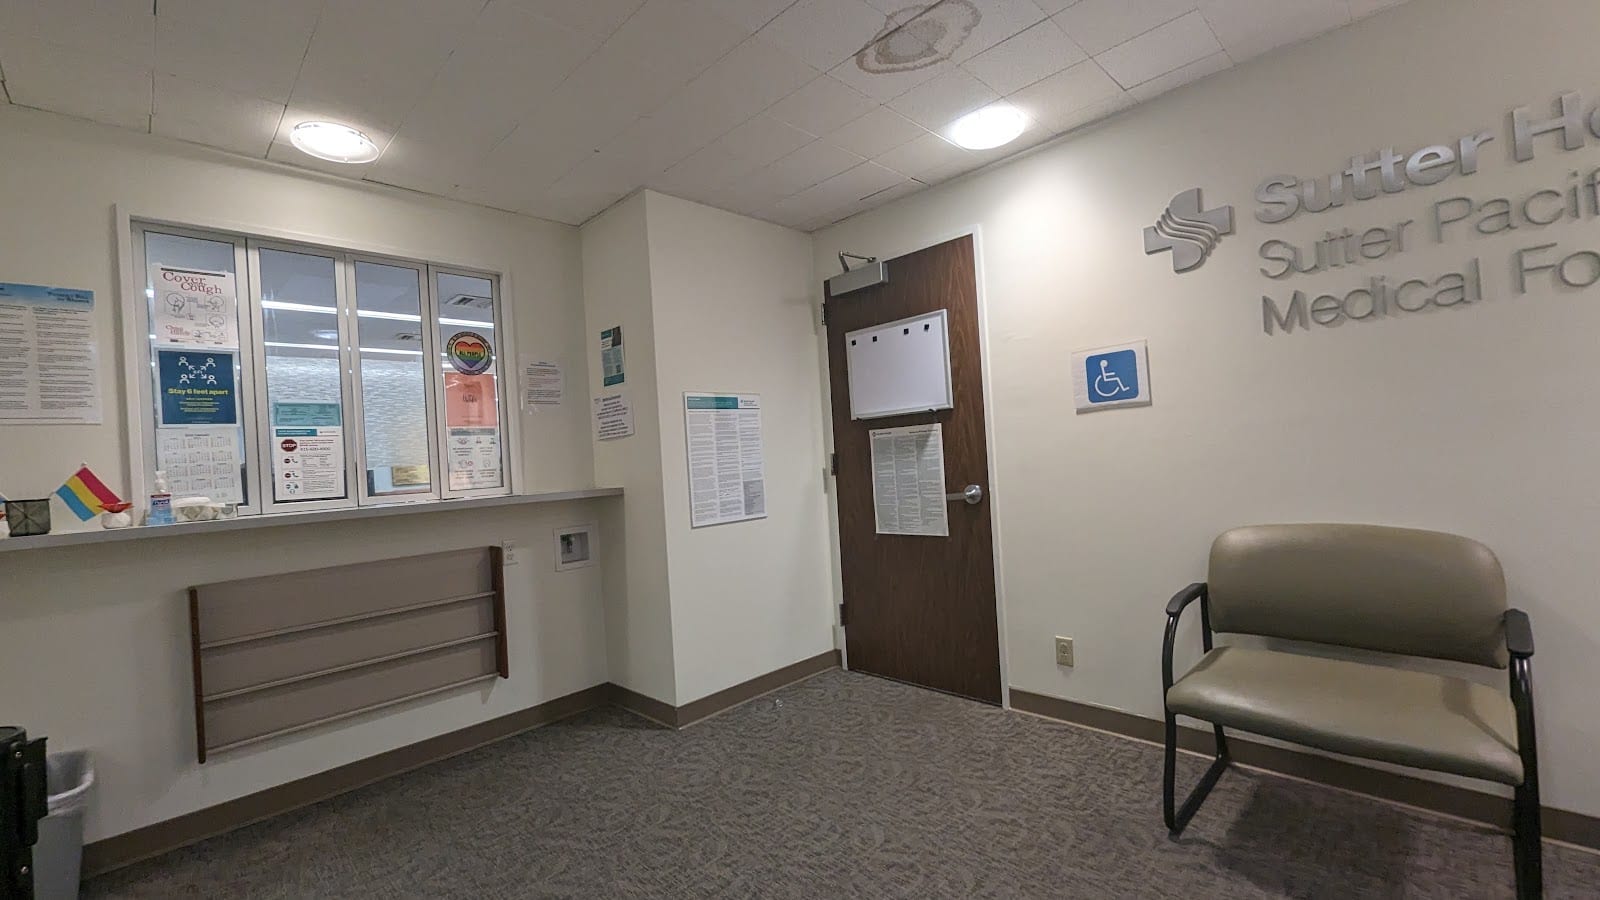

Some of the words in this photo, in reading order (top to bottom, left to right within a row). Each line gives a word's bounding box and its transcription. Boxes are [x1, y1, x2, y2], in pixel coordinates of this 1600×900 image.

[1254, 130, 1495, 224] Sutter
[1511, 92, 1600, 162] H
[1259, 219, 1414, 279] Sutter
[162, 271, 206, 285] Cover
[180, 281, 222, 296] Cough
[1261, 257, 1483, 337] Medical
[1514, 242, 1600, 294] Fo
[167, 388, 186, 396] Stay
